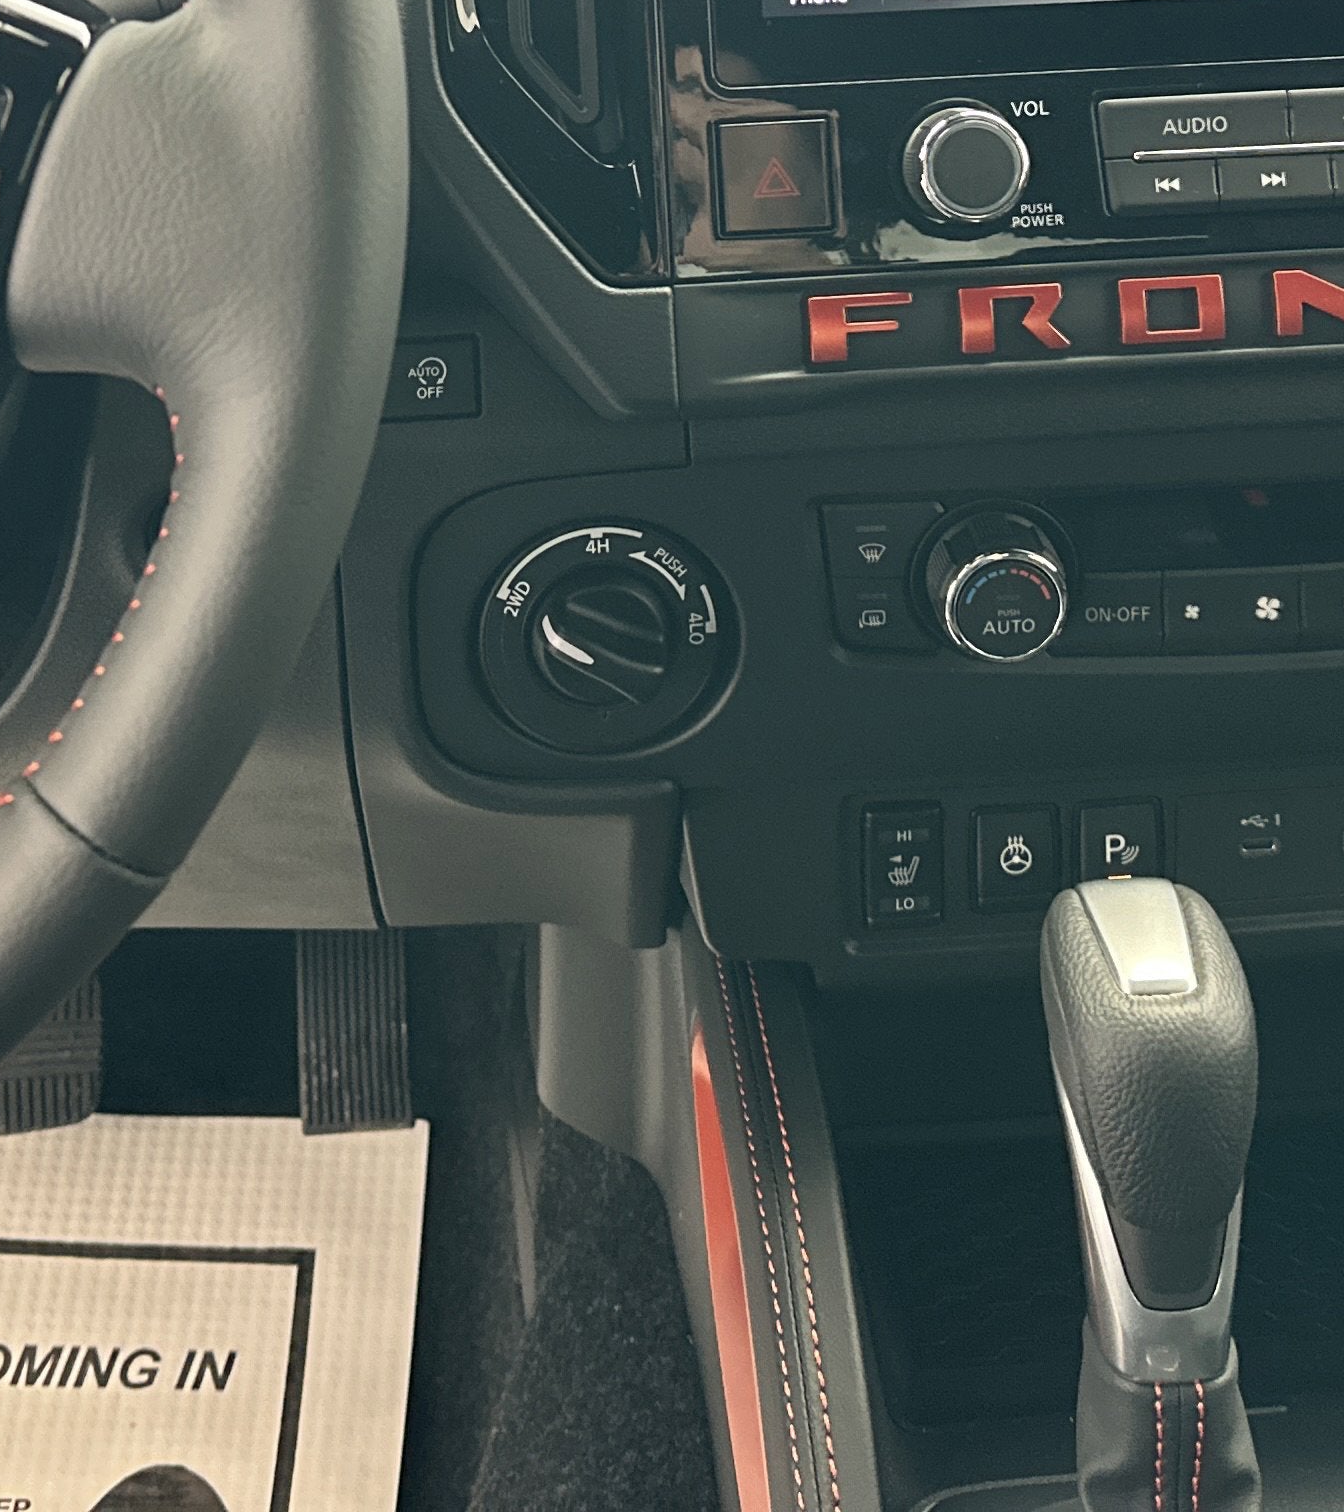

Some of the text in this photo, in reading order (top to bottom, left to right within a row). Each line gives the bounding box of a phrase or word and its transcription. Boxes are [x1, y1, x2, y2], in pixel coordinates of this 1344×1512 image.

[1010, 100, 1050, 117] VOL
[1162, 116, 1228, 136] AUDIO
[1020, 202, 1053, 215] PUSH
[1011, 214, 1064, 228] POWER
[408, 365, 440, 378] AUTO
[416, 385, 445, 400] OFF
[586, 538, 610, 554] 4H
[653, 546, 688, 578] PUSH
[503, 580, 531, 617] 2WD
[688, 611, 704, 646] 4LO
[982, 618, 1036, 635] AUTO
[896, 829, 912, 842] HI
[895, 897, 915, 911] LO
[175, 1350, 237, 1391] IN
